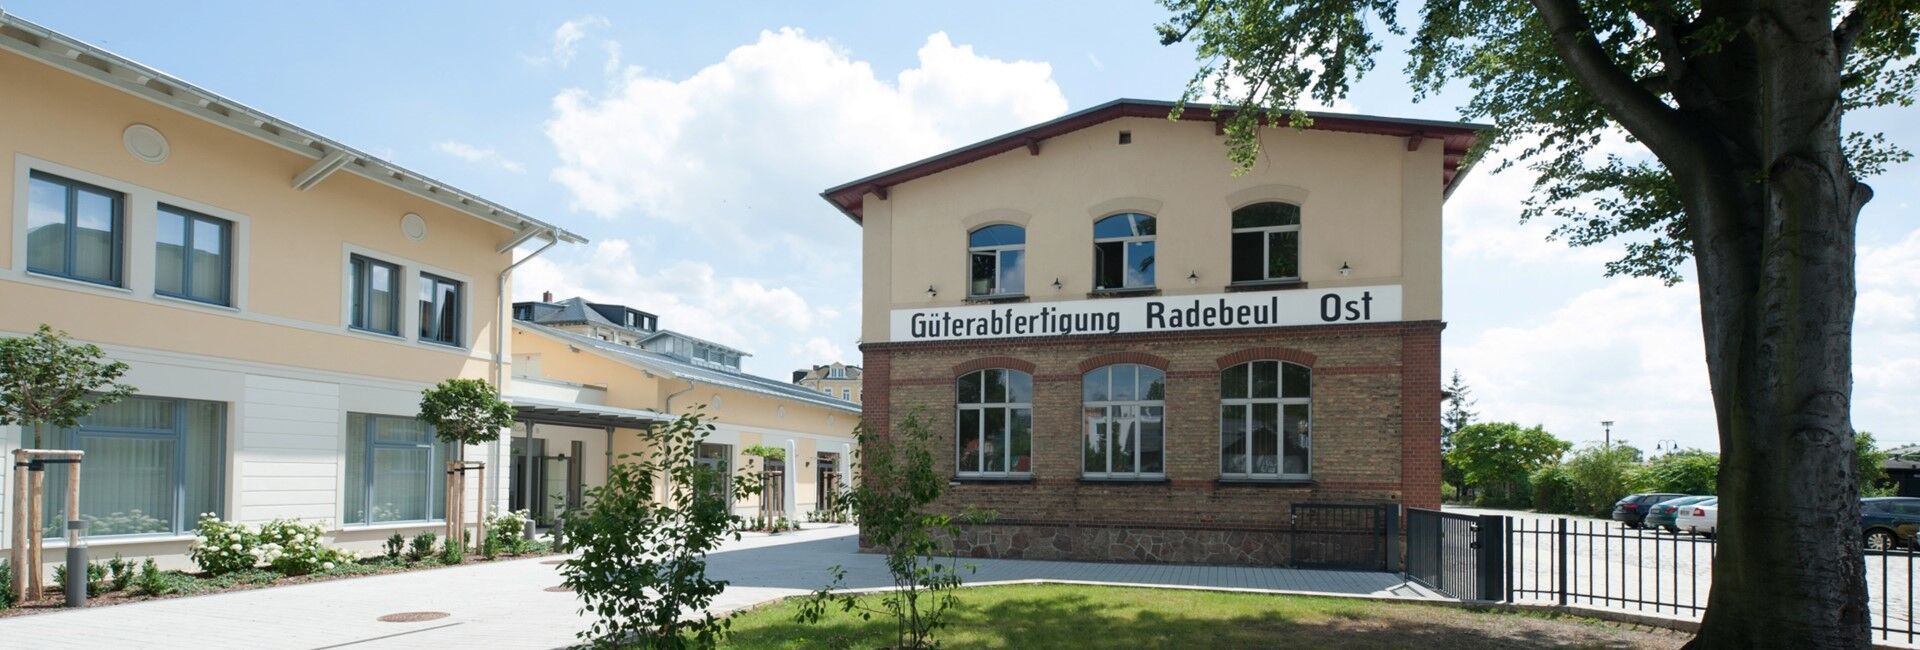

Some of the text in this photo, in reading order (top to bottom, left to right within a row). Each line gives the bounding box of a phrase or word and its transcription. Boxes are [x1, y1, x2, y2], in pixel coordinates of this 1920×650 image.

[911, 291, 1373, 338] Güterabfertigung Radebeul Ost
